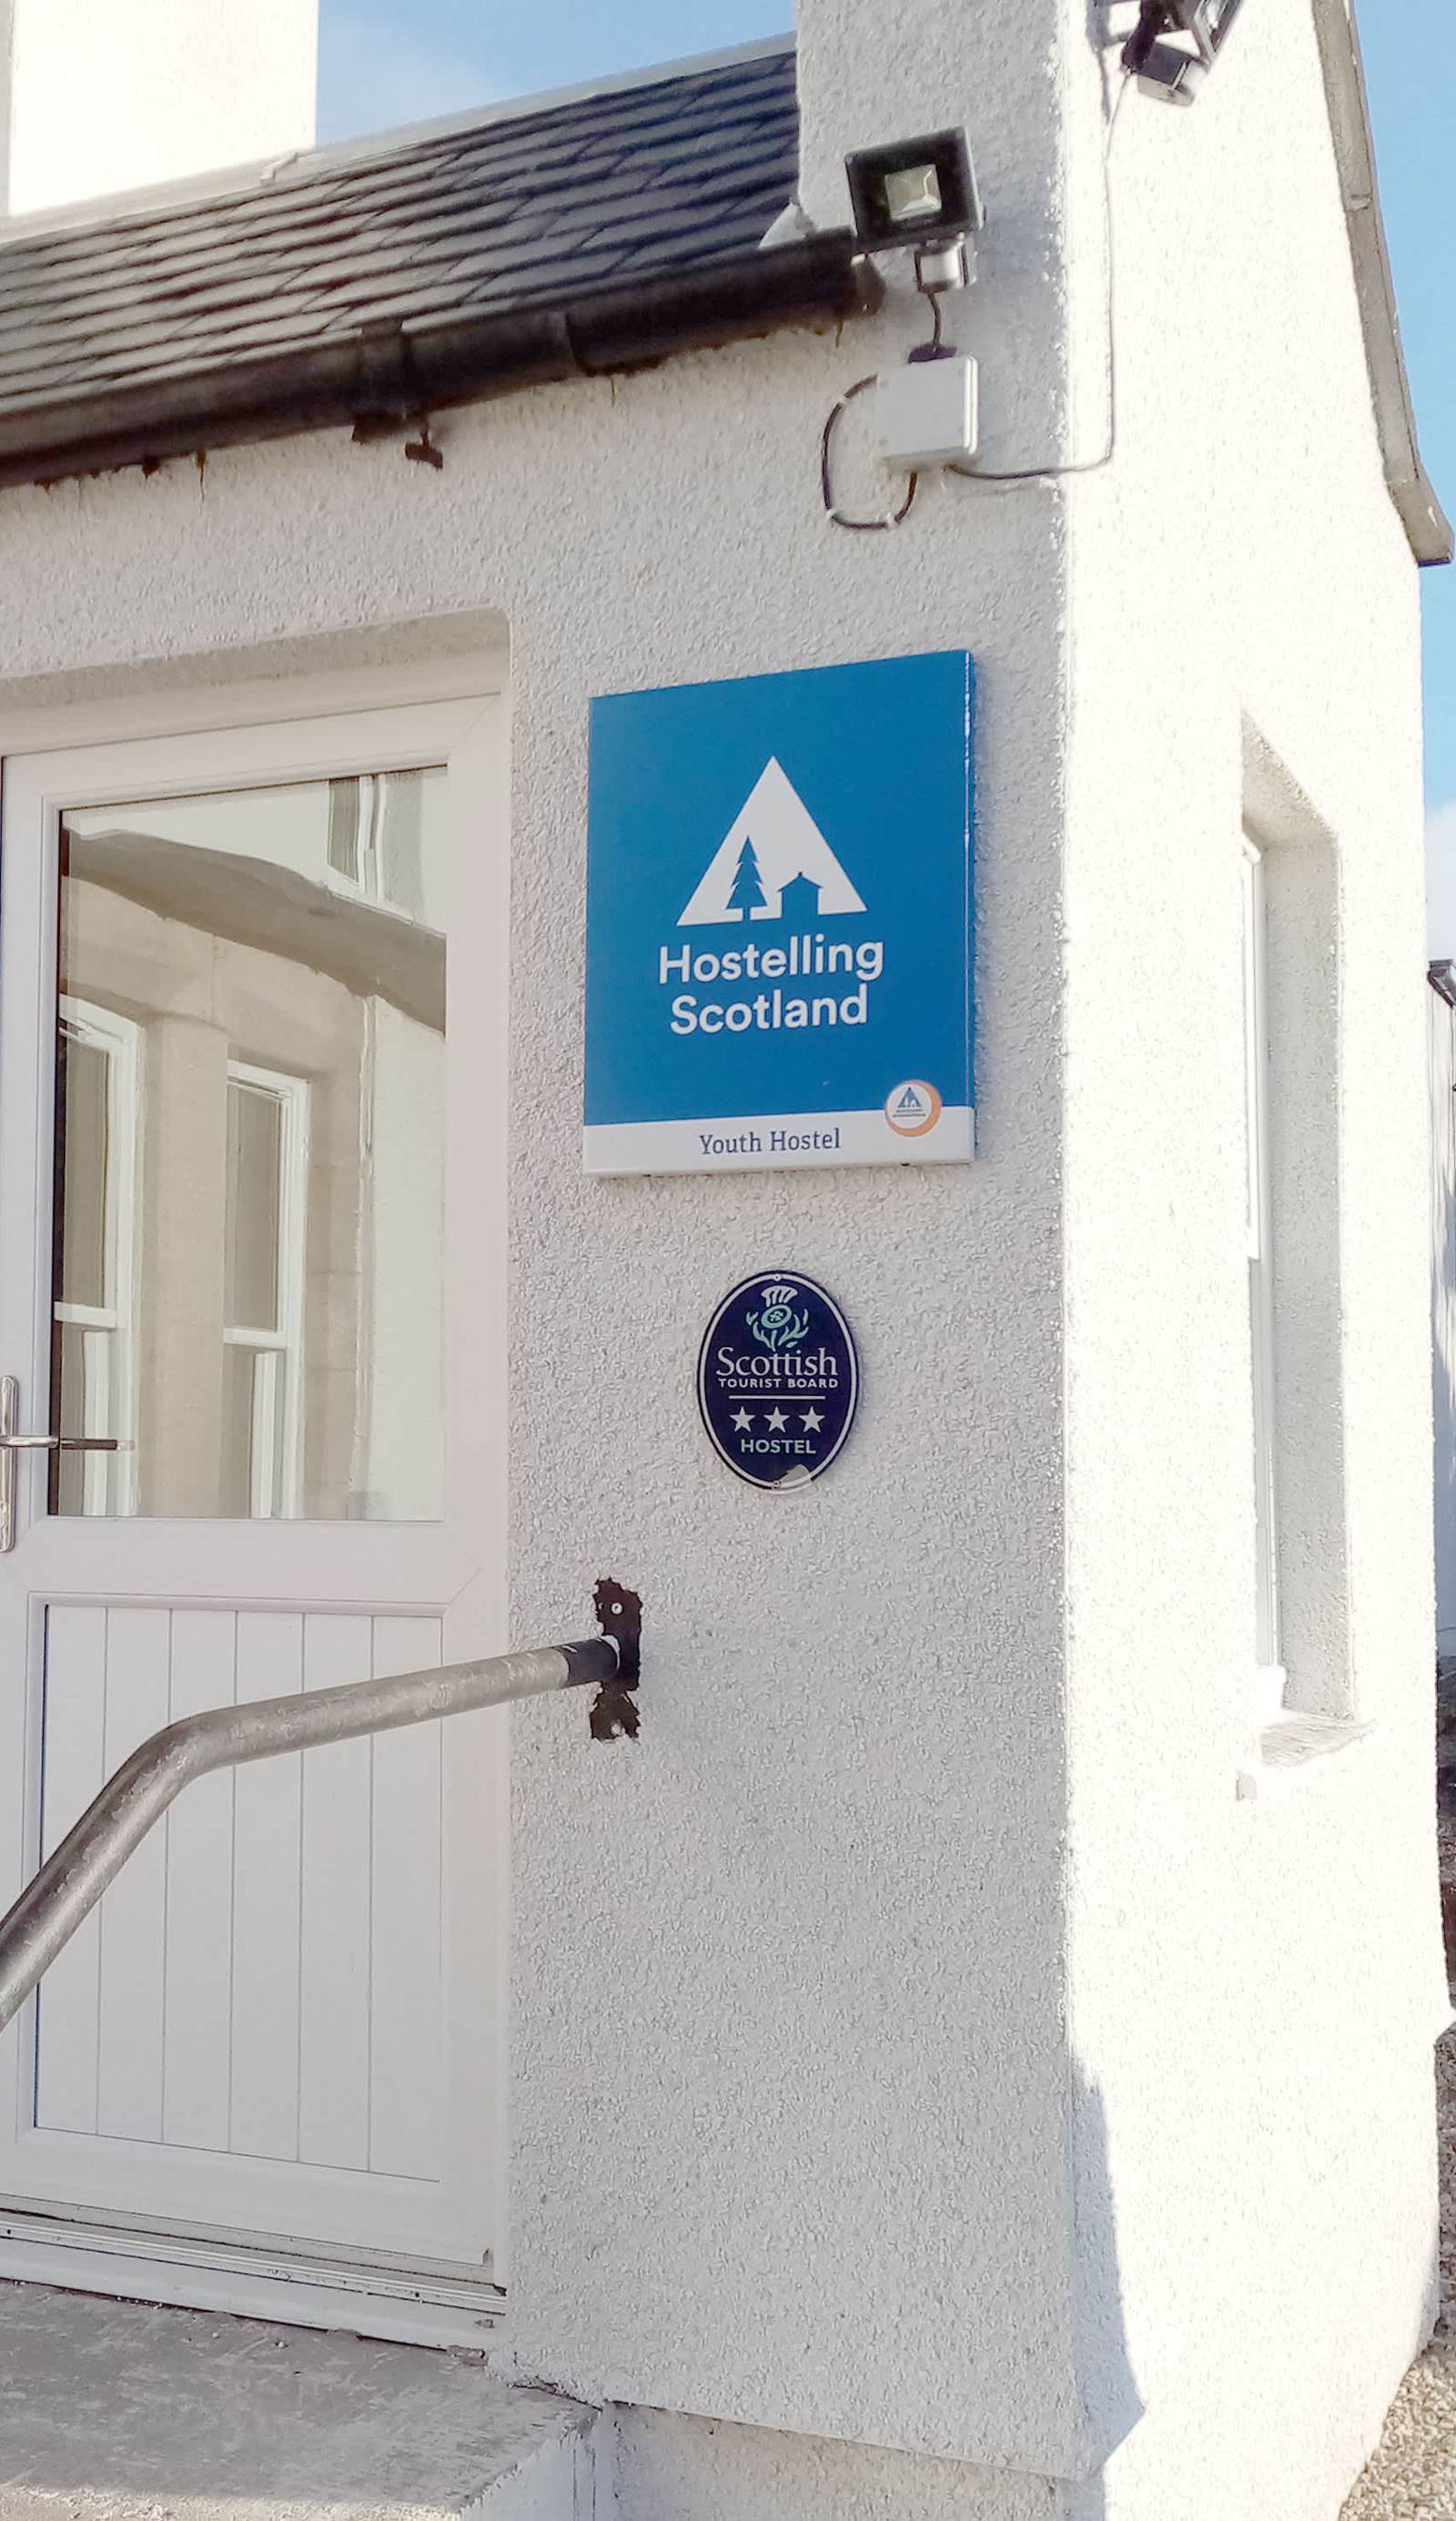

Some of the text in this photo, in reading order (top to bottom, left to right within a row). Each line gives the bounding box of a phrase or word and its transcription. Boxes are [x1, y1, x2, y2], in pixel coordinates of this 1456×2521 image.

[659, 934, 884, 984] Hostelling
[670, 984, 868, 1035] Scotland
[699, 1128, 841, 1155] Youth Hostel
[715, 1346, 838, 1376] Scottish
[718, 1378, 838, 1388] TOURIST BOARD
[741, 1439, 816, 1453] HOSTEL
